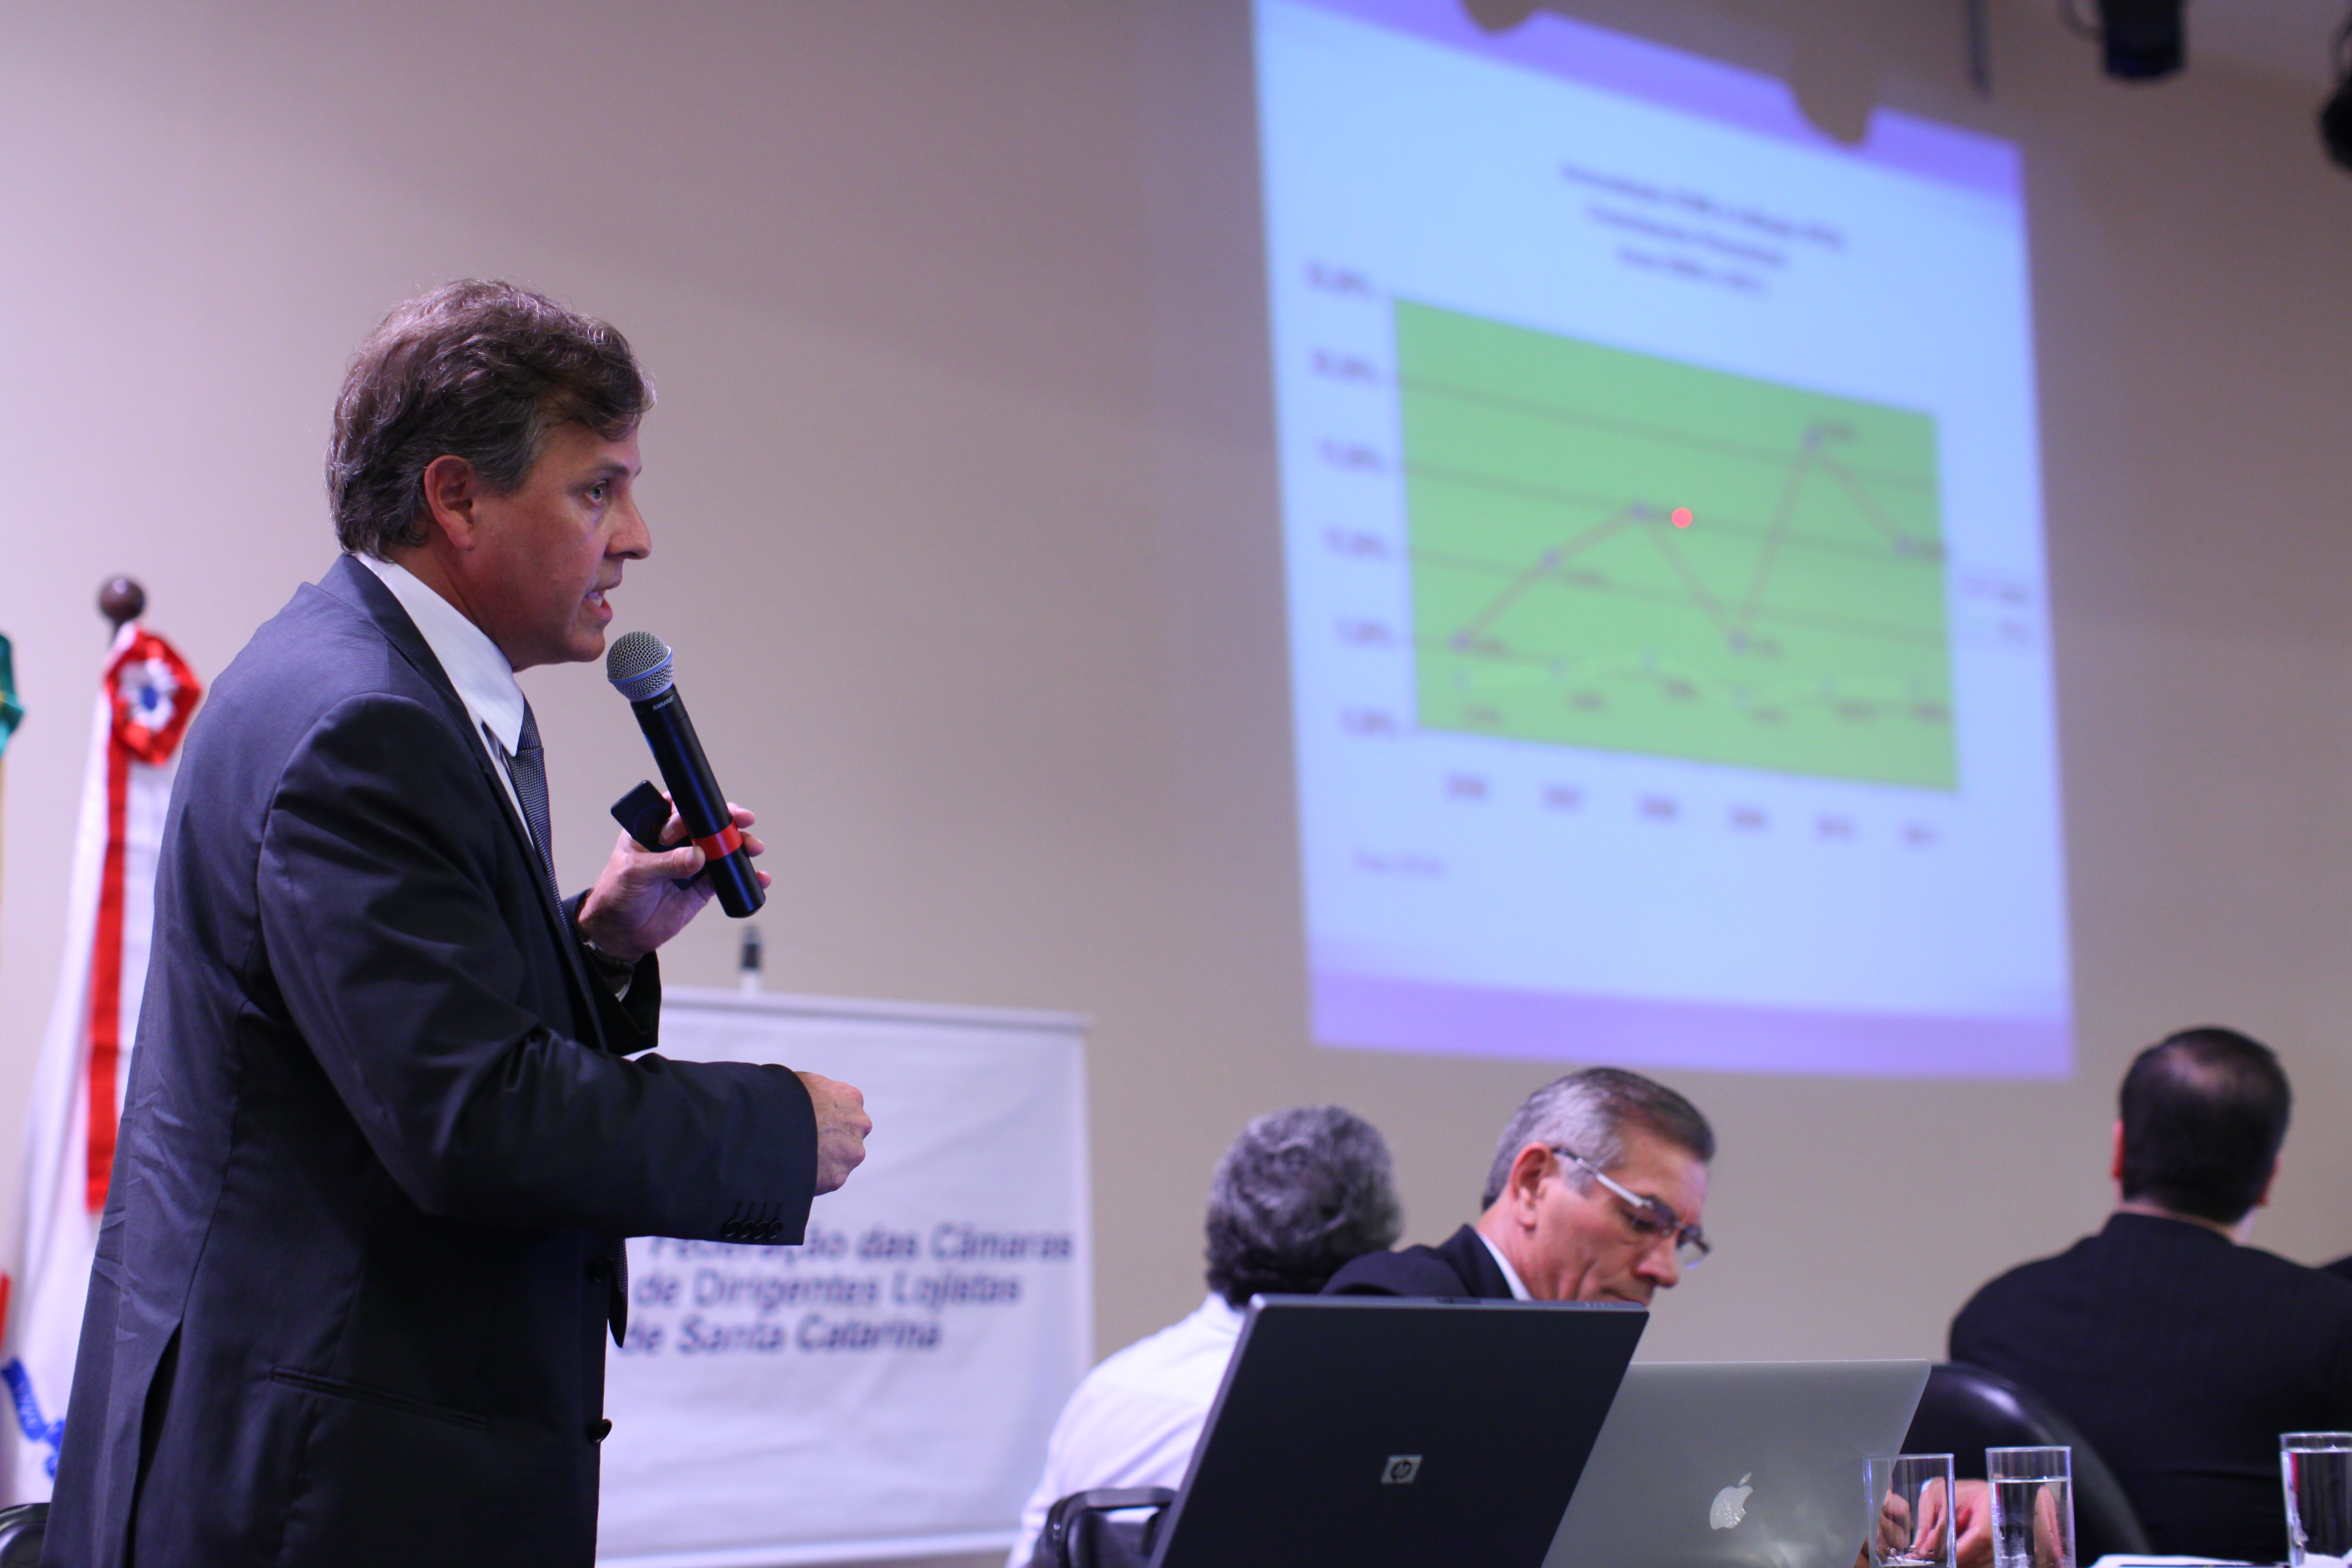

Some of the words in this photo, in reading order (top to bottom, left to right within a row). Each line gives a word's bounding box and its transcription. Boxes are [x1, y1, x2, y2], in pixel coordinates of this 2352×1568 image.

[652, 694, 675, 711] SHURE
[855, 1224, 919, 1261] das
[932, 1222, 1073, 1261] Câmaras
[633, 1271, 681, 1305] de
[693, 1268, 879, 1313] Dirigentes
[891, 1270, 1020, 1310] Lojistas
[626, 1317, 664, 1353] de
[679, 1314, 785, 1353] Santa
[795, 1312, 942, 1350] Catarina
